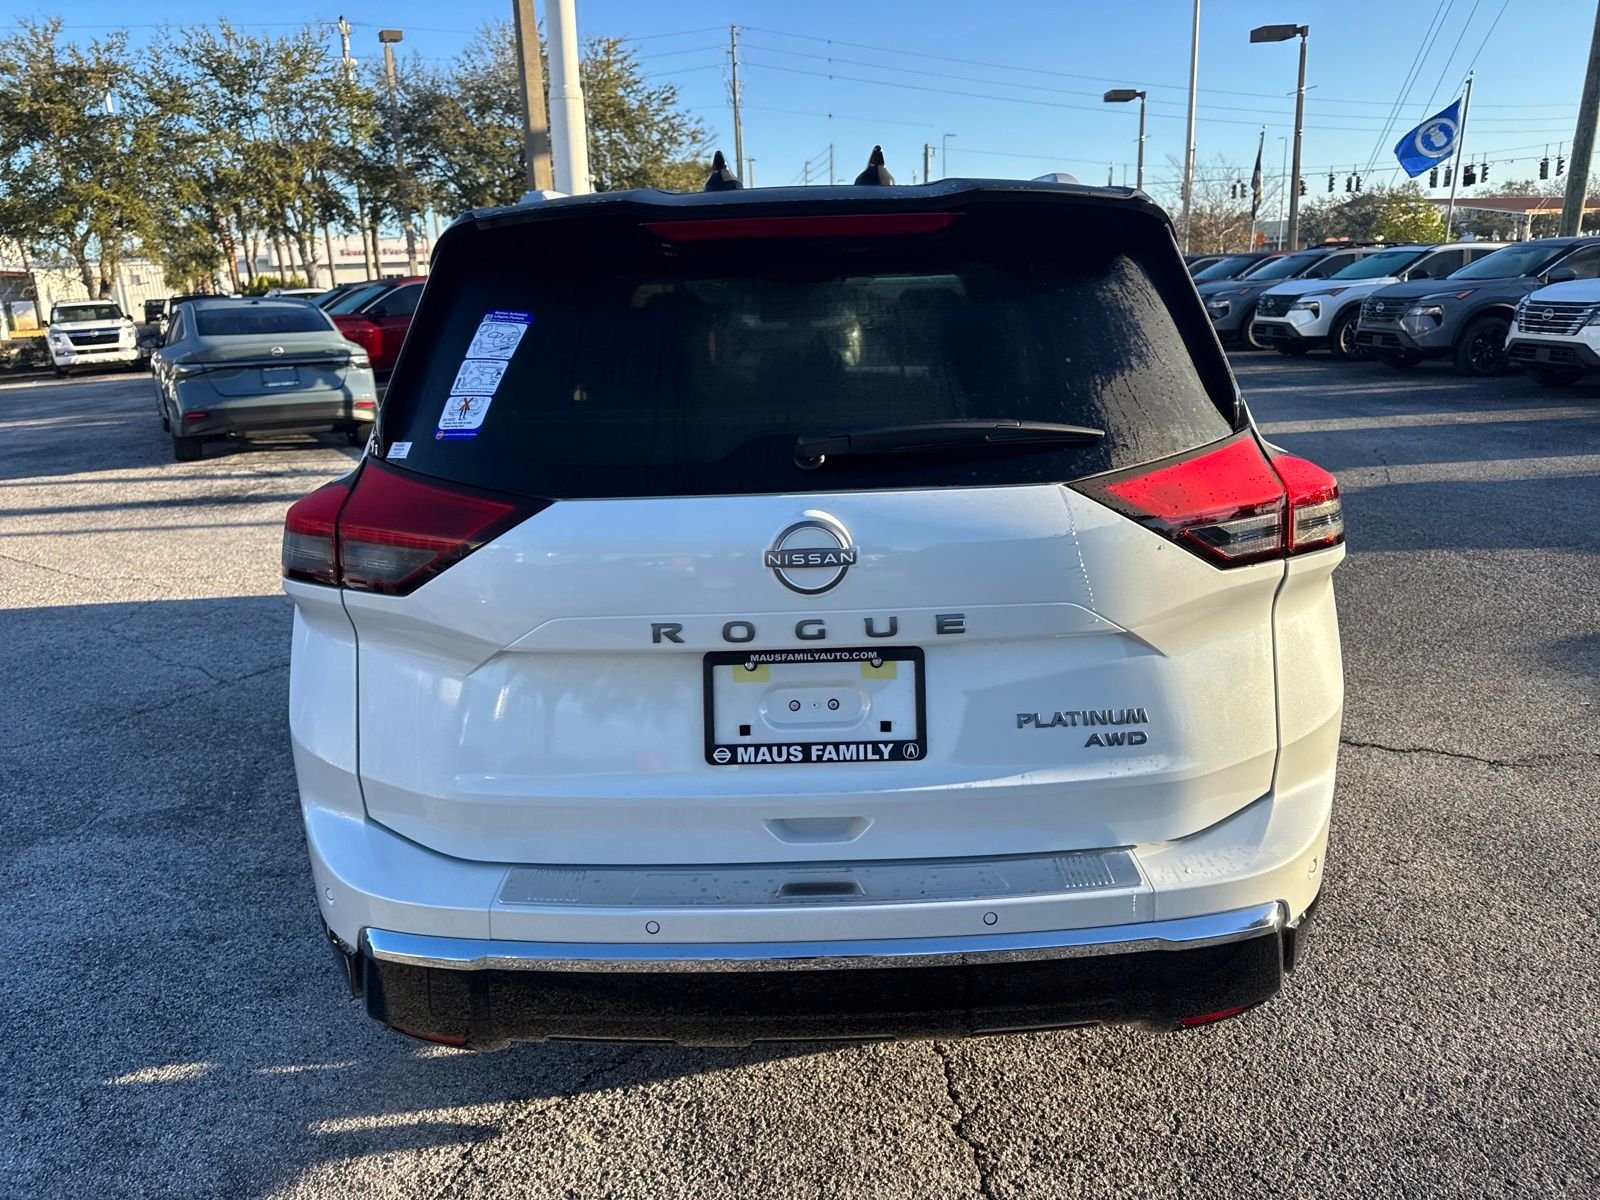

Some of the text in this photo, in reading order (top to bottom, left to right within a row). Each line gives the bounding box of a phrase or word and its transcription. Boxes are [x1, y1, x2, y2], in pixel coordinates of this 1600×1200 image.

[767, 552, 854, 565] NISSAN
[651, 613, 967, 644] ROGUE
[750, 651, 878, 662] MAUSFAMILYAUTO.COM
[1016, 707, 1150, 729] PLATINUM
[1083, 731, 1149, 748] AWD
[737, 743, 894, 763] MAUS FAMILY
